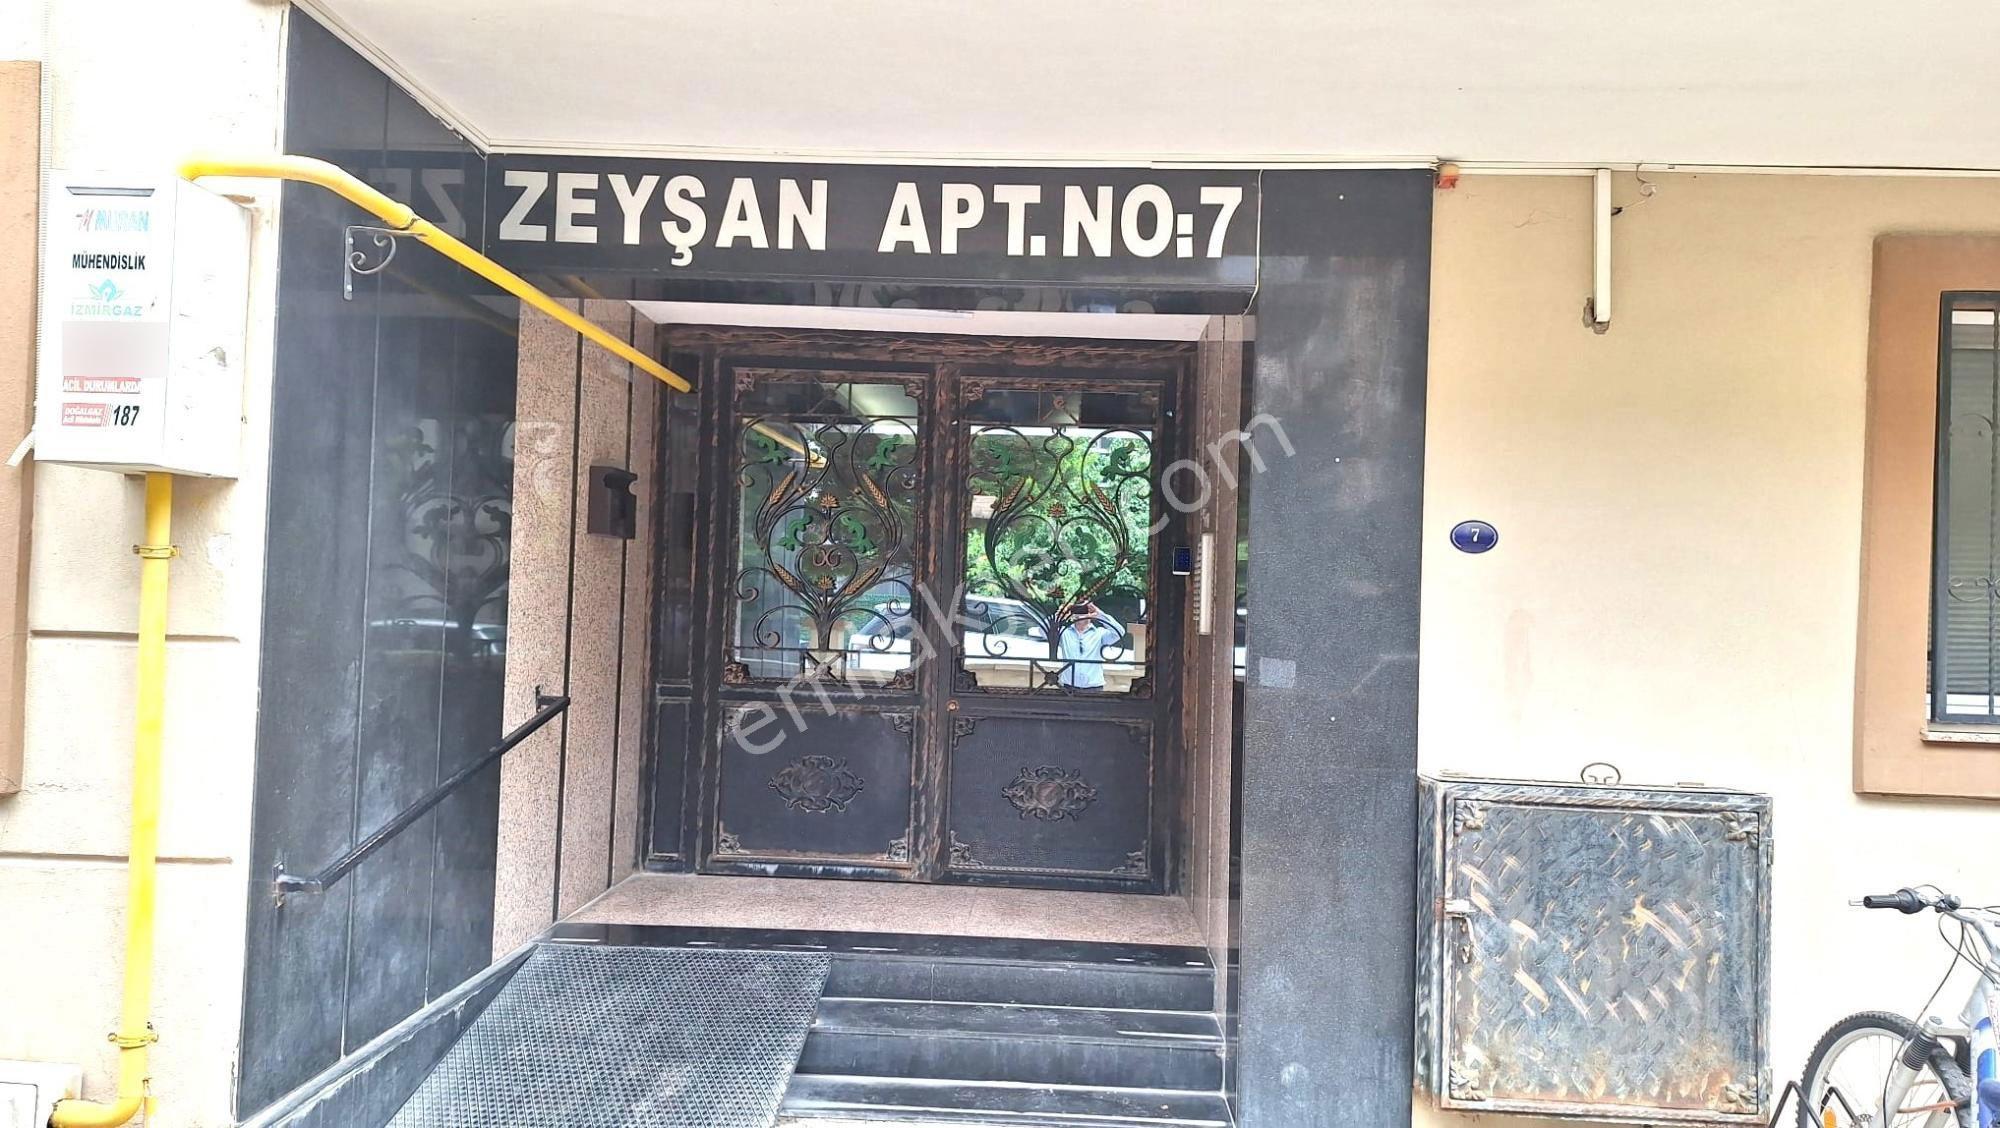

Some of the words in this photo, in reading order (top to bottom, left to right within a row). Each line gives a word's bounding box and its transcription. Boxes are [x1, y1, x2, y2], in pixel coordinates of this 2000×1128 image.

[499, 170, 828, 266] ZEYŞAN
[72, 250, 146, 271] MÜHENDİSLİK
[71, 301, 143, 317] İZMİRGAZ
[113, 404, 140, 427] 187
[1471, 527, 1480, 543] 7
